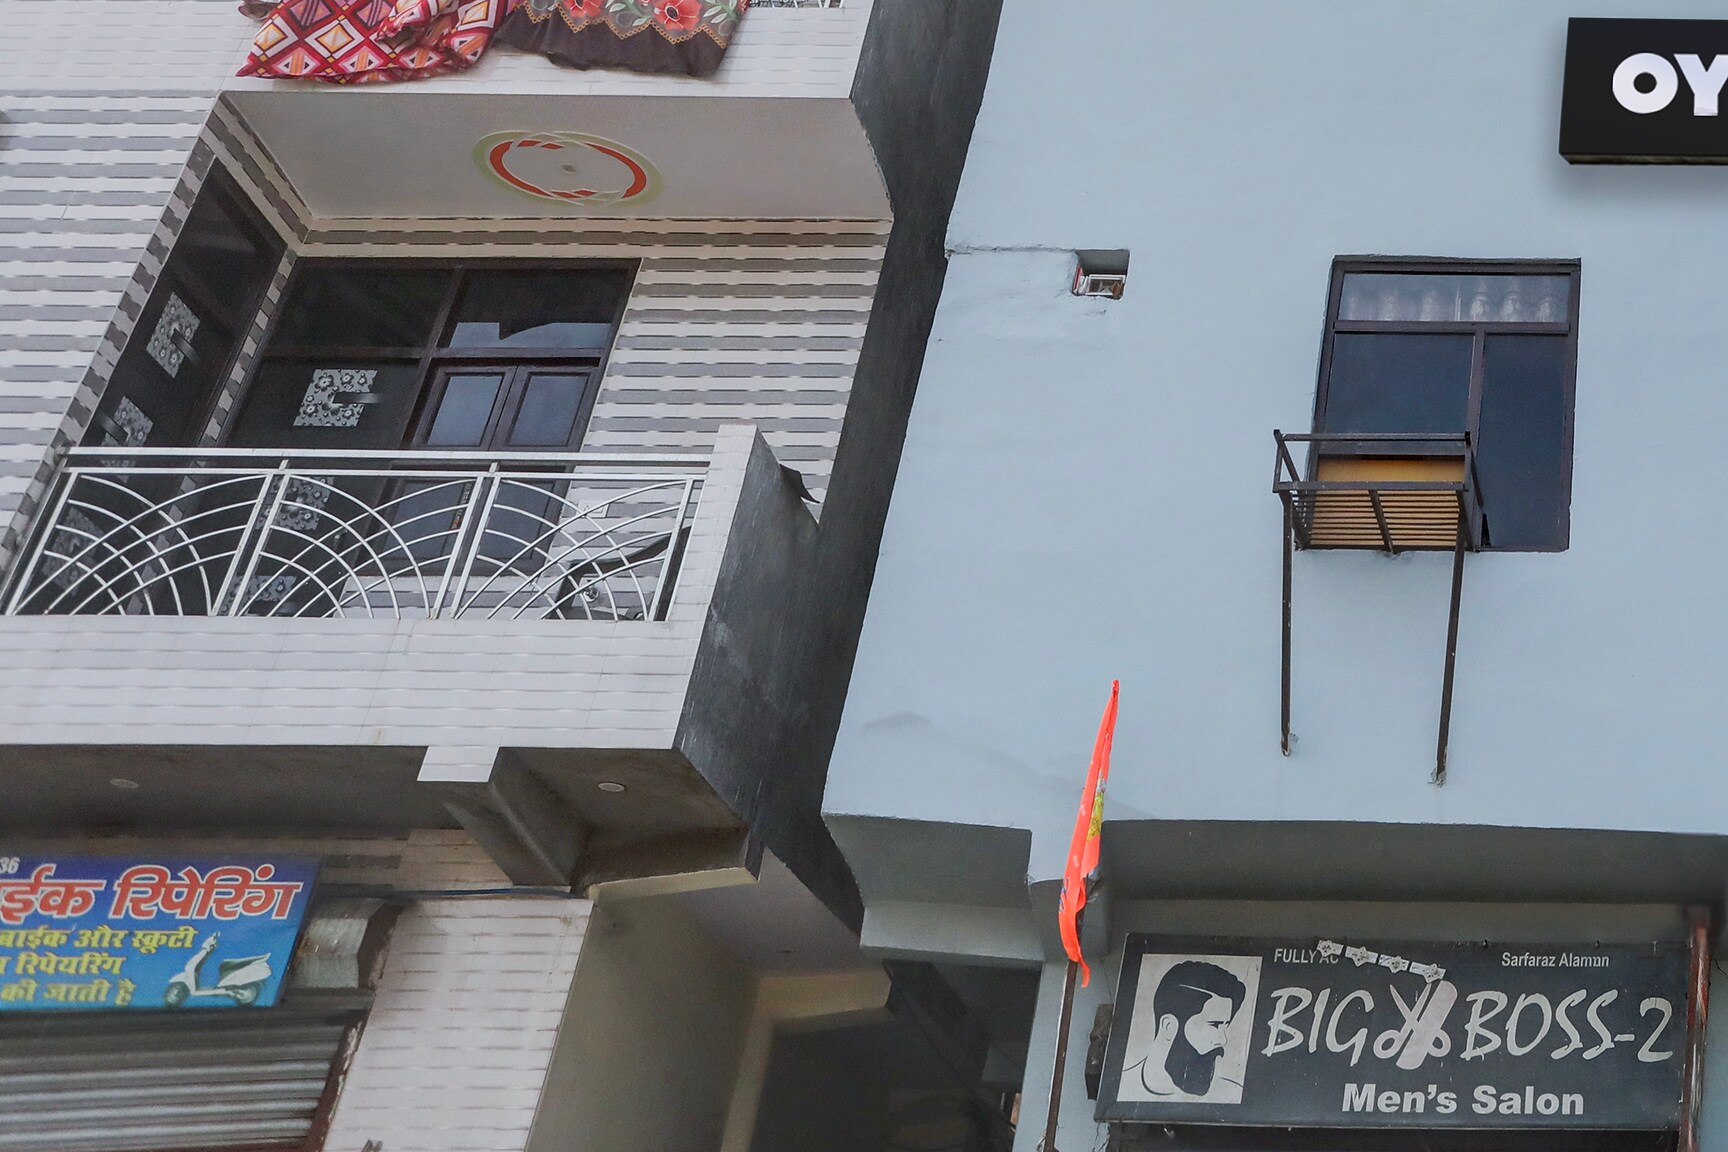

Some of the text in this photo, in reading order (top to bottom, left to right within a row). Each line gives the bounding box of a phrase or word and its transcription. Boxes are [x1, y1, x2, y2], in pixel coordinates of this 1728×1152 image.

[108, 863, 304, 921] रिपेरिंग
[73, 923, 129, 948] और
[1274, 948, 1317, 964] FULLY
[1501, 951, 1556, 967] Sarfaraz
[115, 978, 137, 1006] है
[1261, 987, 1673, 1067] BIG BOSS-2
[1342, 1083, 1584, 1115] Men's Salon
